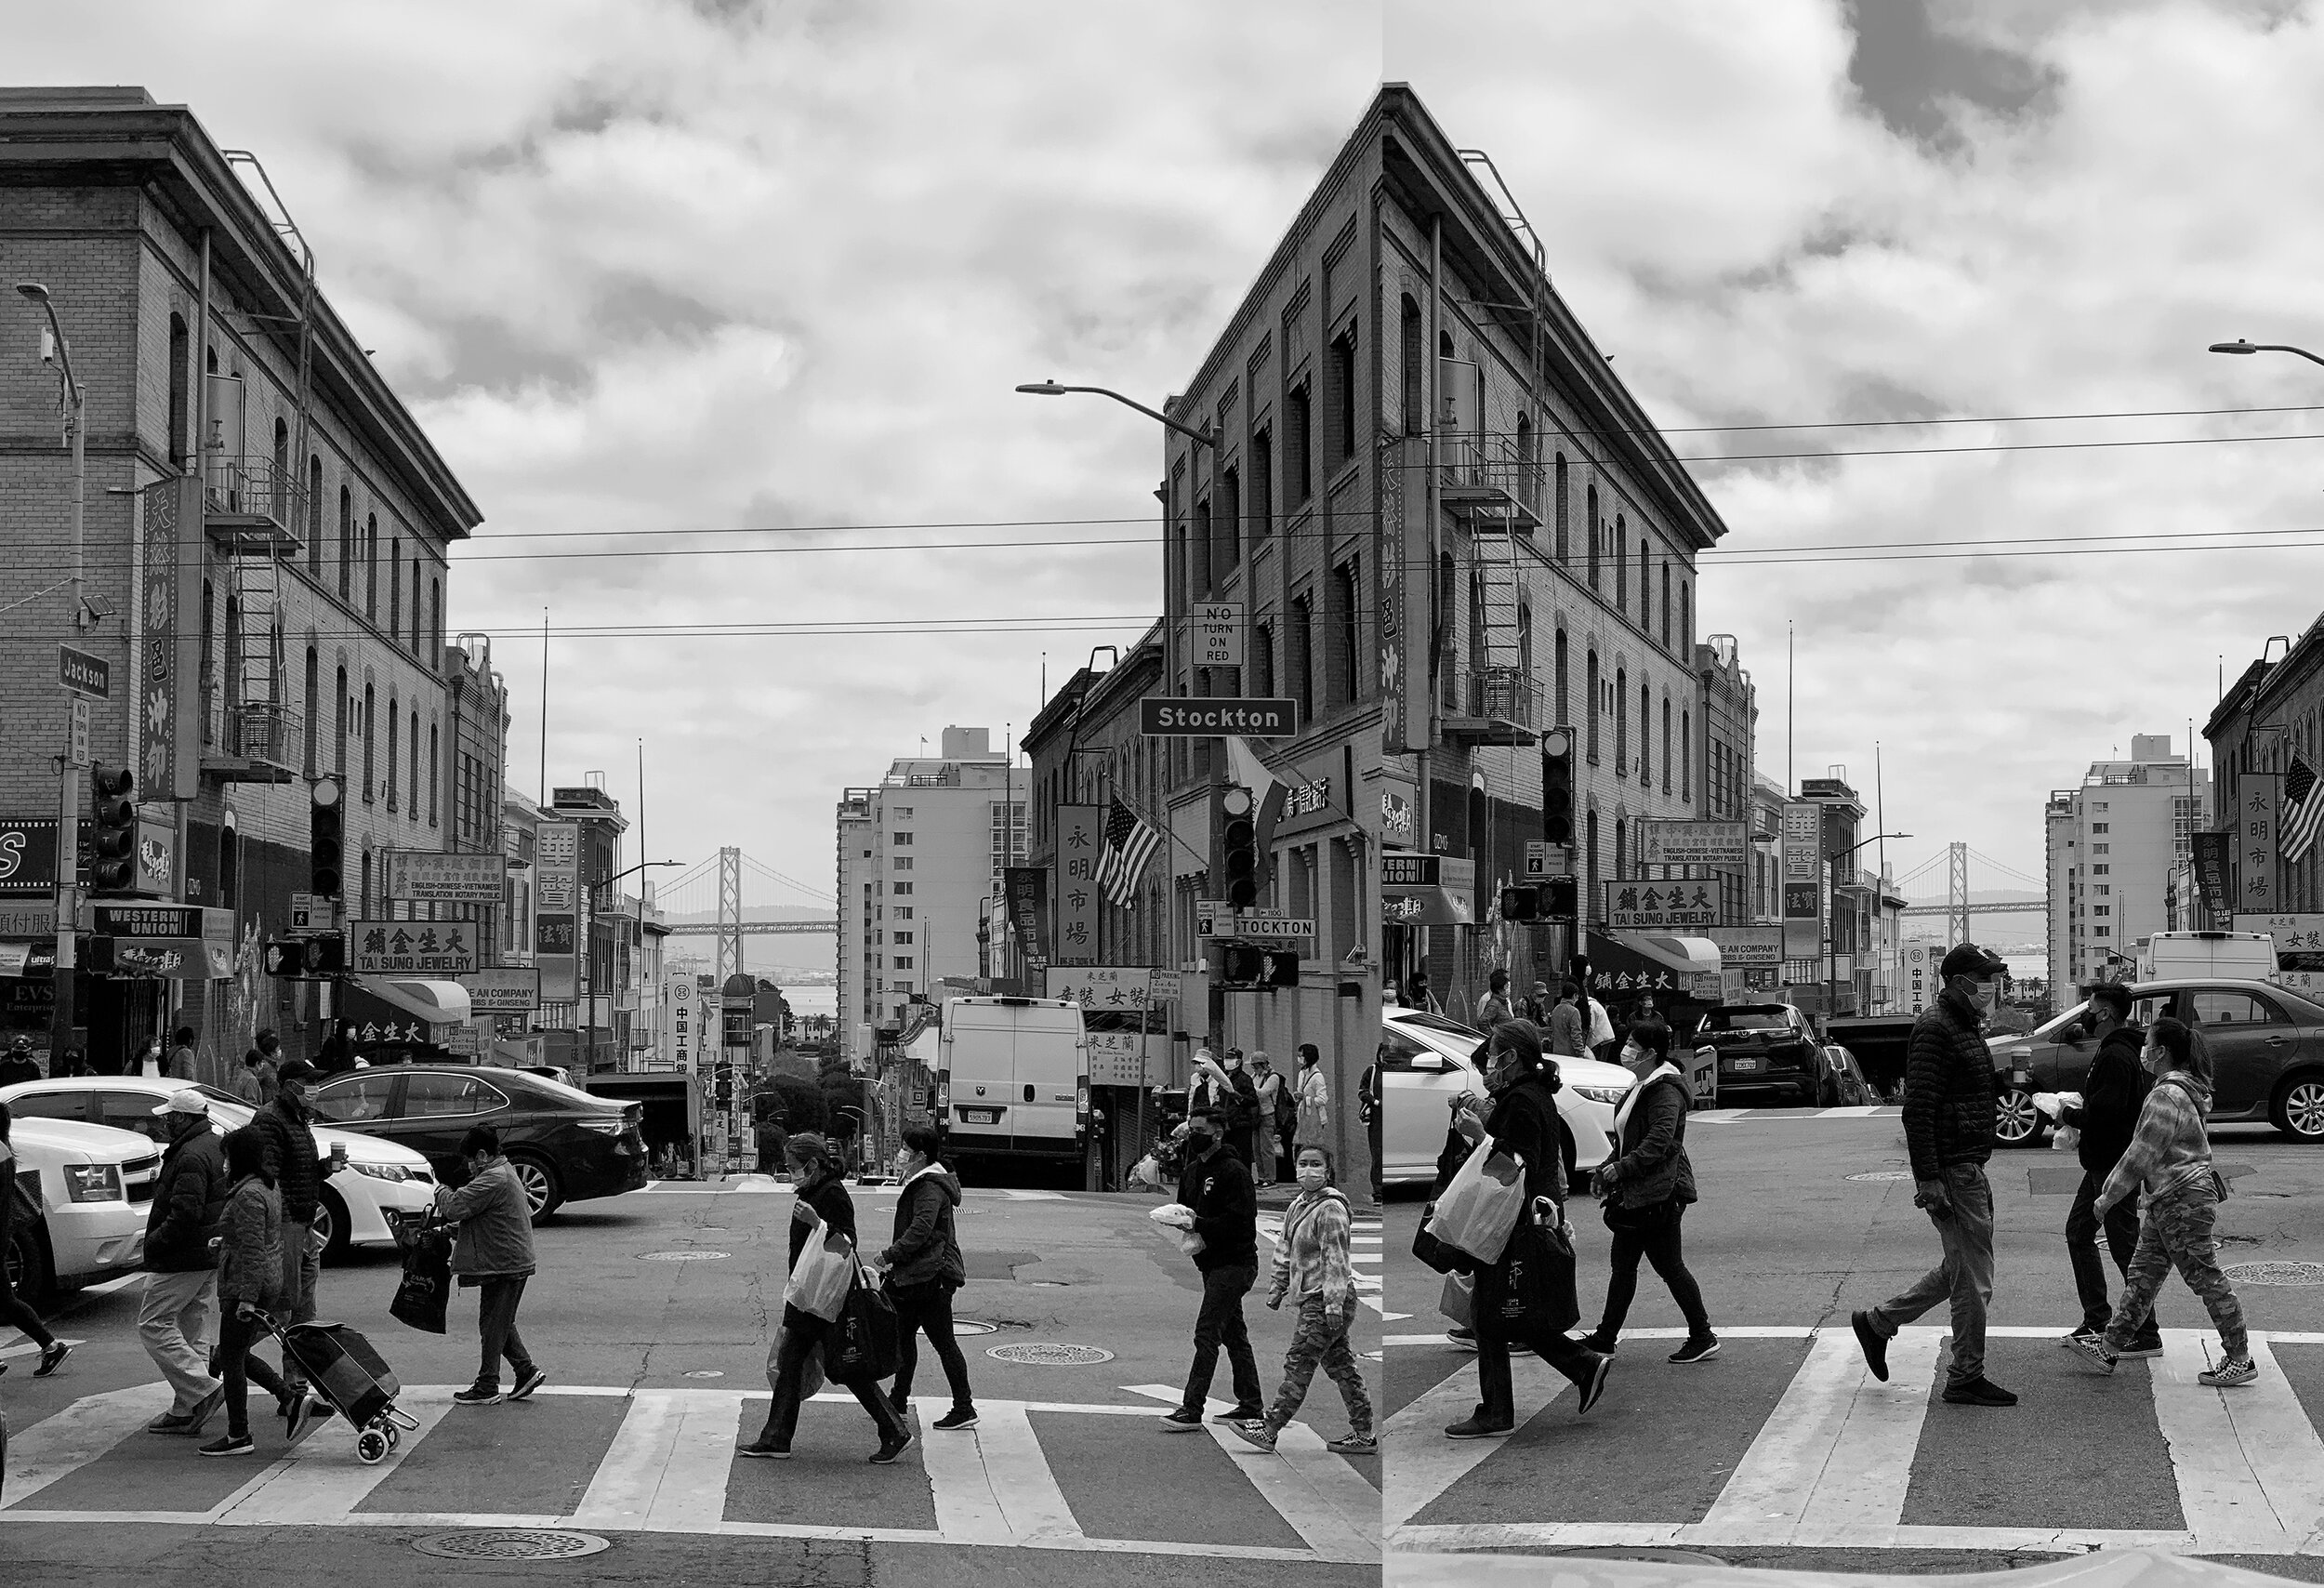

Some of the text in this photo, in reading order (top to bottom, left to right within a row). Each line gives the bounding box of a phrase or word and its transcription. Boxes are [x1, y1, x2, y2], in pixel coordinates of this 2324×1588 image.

[1207, 607, 1231, 620] NO
[1203, 624, 1233, 633] TURN
[1209, 637, 1226, 647] ON
[1207, 651, 1229, 661] RED
[64, 656, 104, 689] Jackson
[1158, 707, 1279, 727] Stockton
[2248, 791, 2269, 897] 永明市場
[1066, 825, 1091, 946] 永明市場
[109, 910, 178, 921] WESTERN
[1614, 911, 1717, 925] TAI SUNG JEWELRY
[0, 913, 58, 933] 付服
[130, 922, 178, 934] UNION
[1740, 945, 1779, 953] COMPANY
[360, 956, 473, 970] TAI SUNG JEWELRY
[476, 988, 489, 998] AN
[491, 988, 535, 998] COMPANY
[496, 999, 531, 1007] GINSENG
